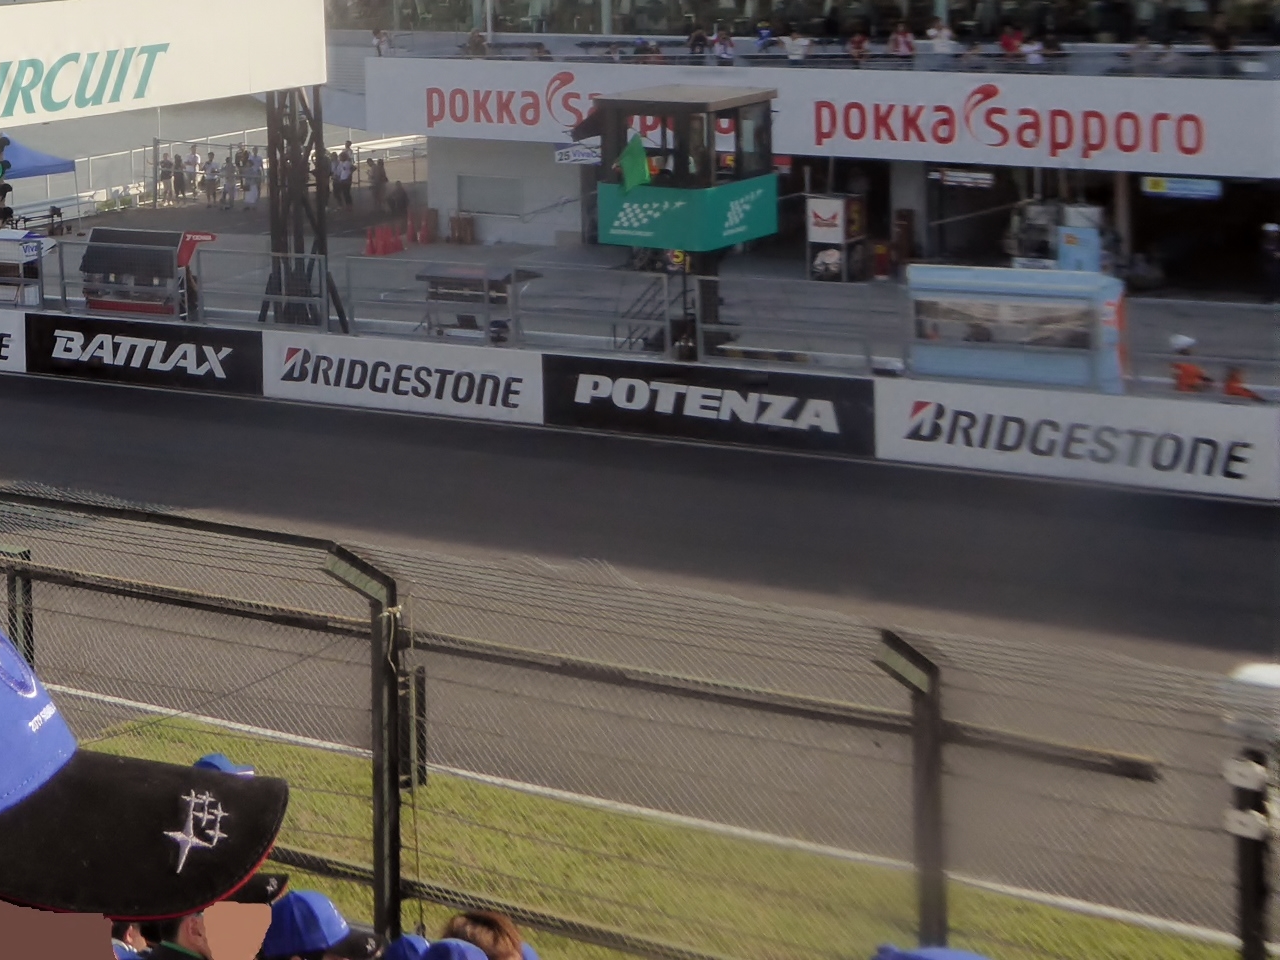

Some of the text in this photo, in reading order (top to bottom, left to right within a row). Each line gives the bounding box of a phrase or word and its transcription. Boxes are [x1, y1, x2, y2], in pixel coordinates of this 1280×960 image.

[982, 106, 1205, 158] sapporo
[51, 328, 233, 379] BATTLAX
[280, 346, 523, 410] BRIDGESTONE
[574, 373, 841, 435] POTENZA
[903, 400, 1255, 480] BRIDGESTONE
